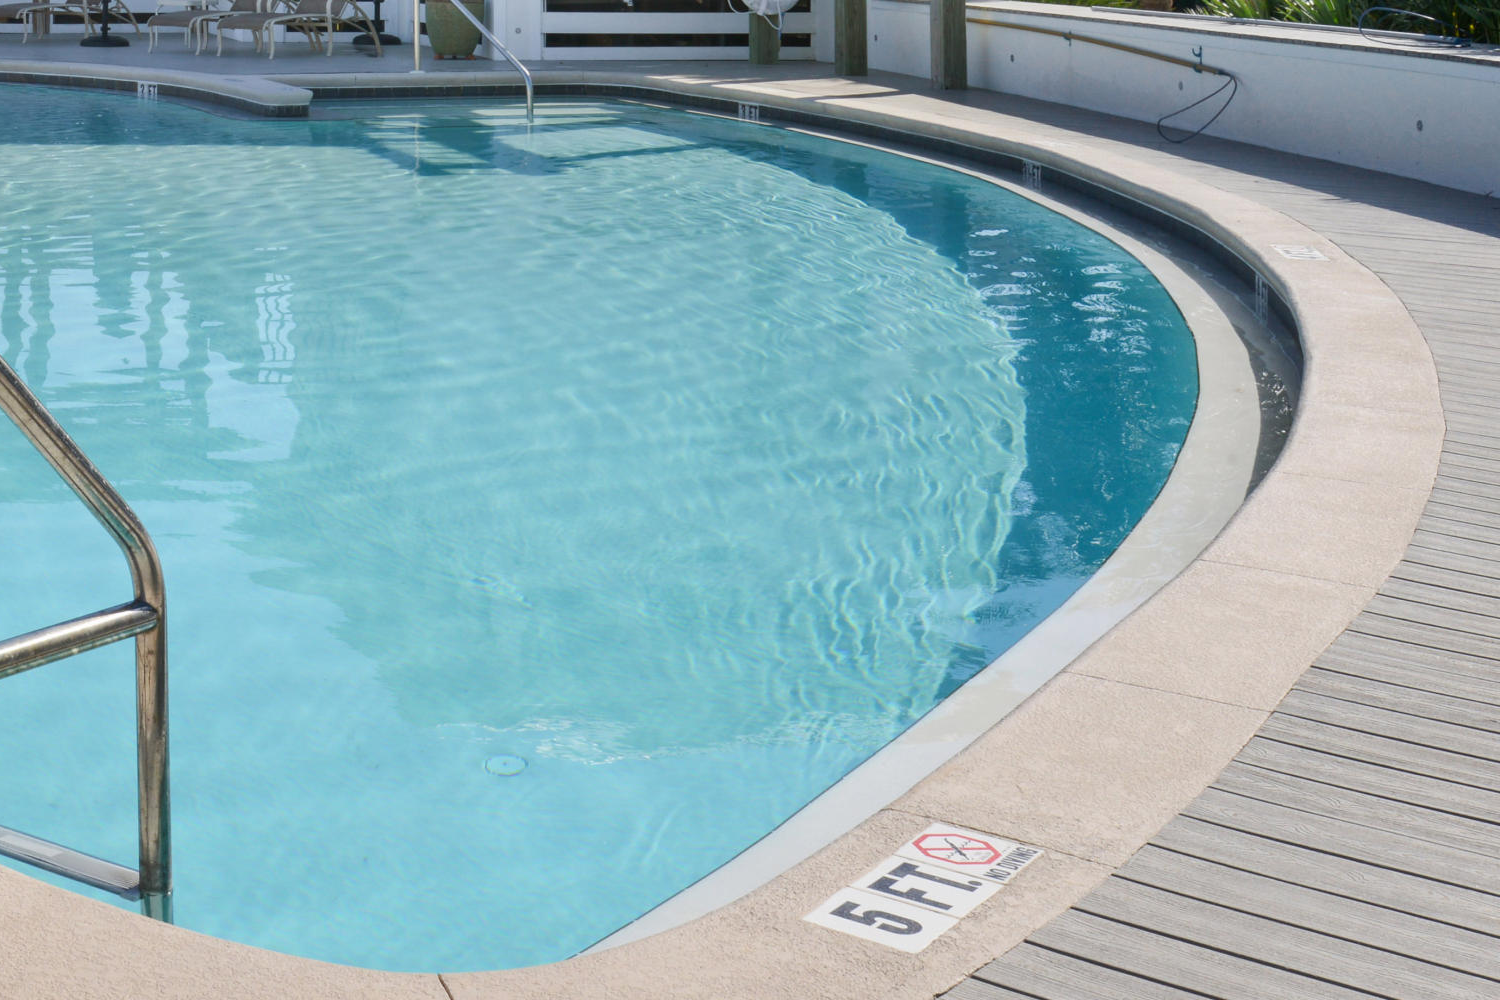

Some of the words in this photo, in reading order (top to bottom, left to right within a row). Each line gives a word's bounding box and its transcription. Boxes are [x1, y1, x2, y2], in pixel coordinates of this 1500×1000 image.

[996, 846, 1039, 870] DIVING
[867, 862, 983, 910] FT.
[983, 868, 1011, 881] NO
[829, 902, 923, 935] 5
